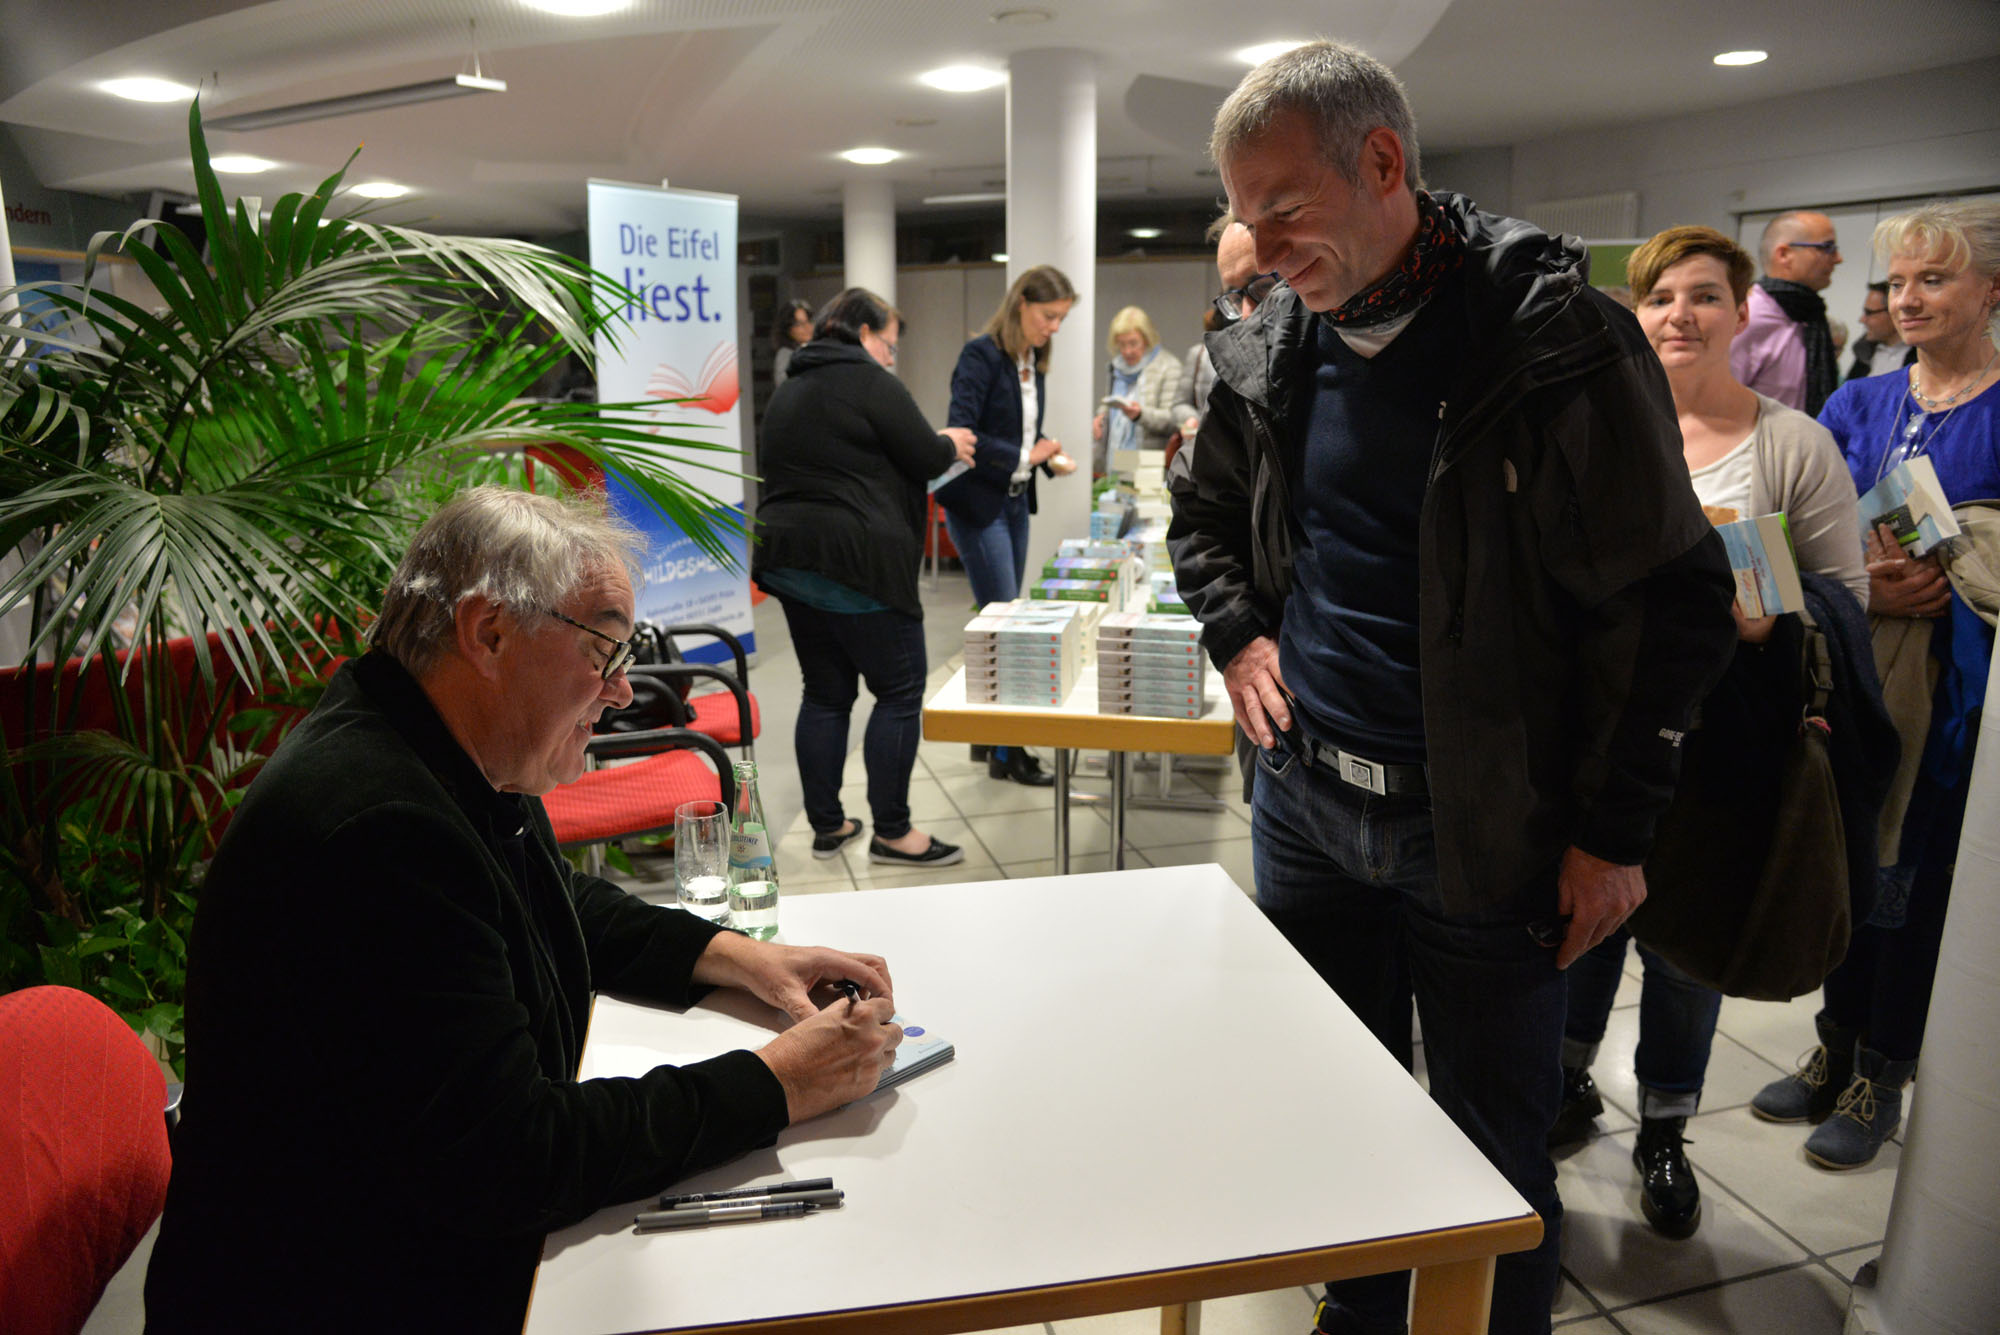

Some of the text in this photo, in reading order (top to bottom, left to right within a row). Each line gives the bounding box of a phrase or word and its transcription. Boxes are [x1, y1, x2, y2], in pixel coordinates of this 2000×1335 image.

[619, 223, 719, 261] Die Eifel
[625, 267, 721, 322] liest.
